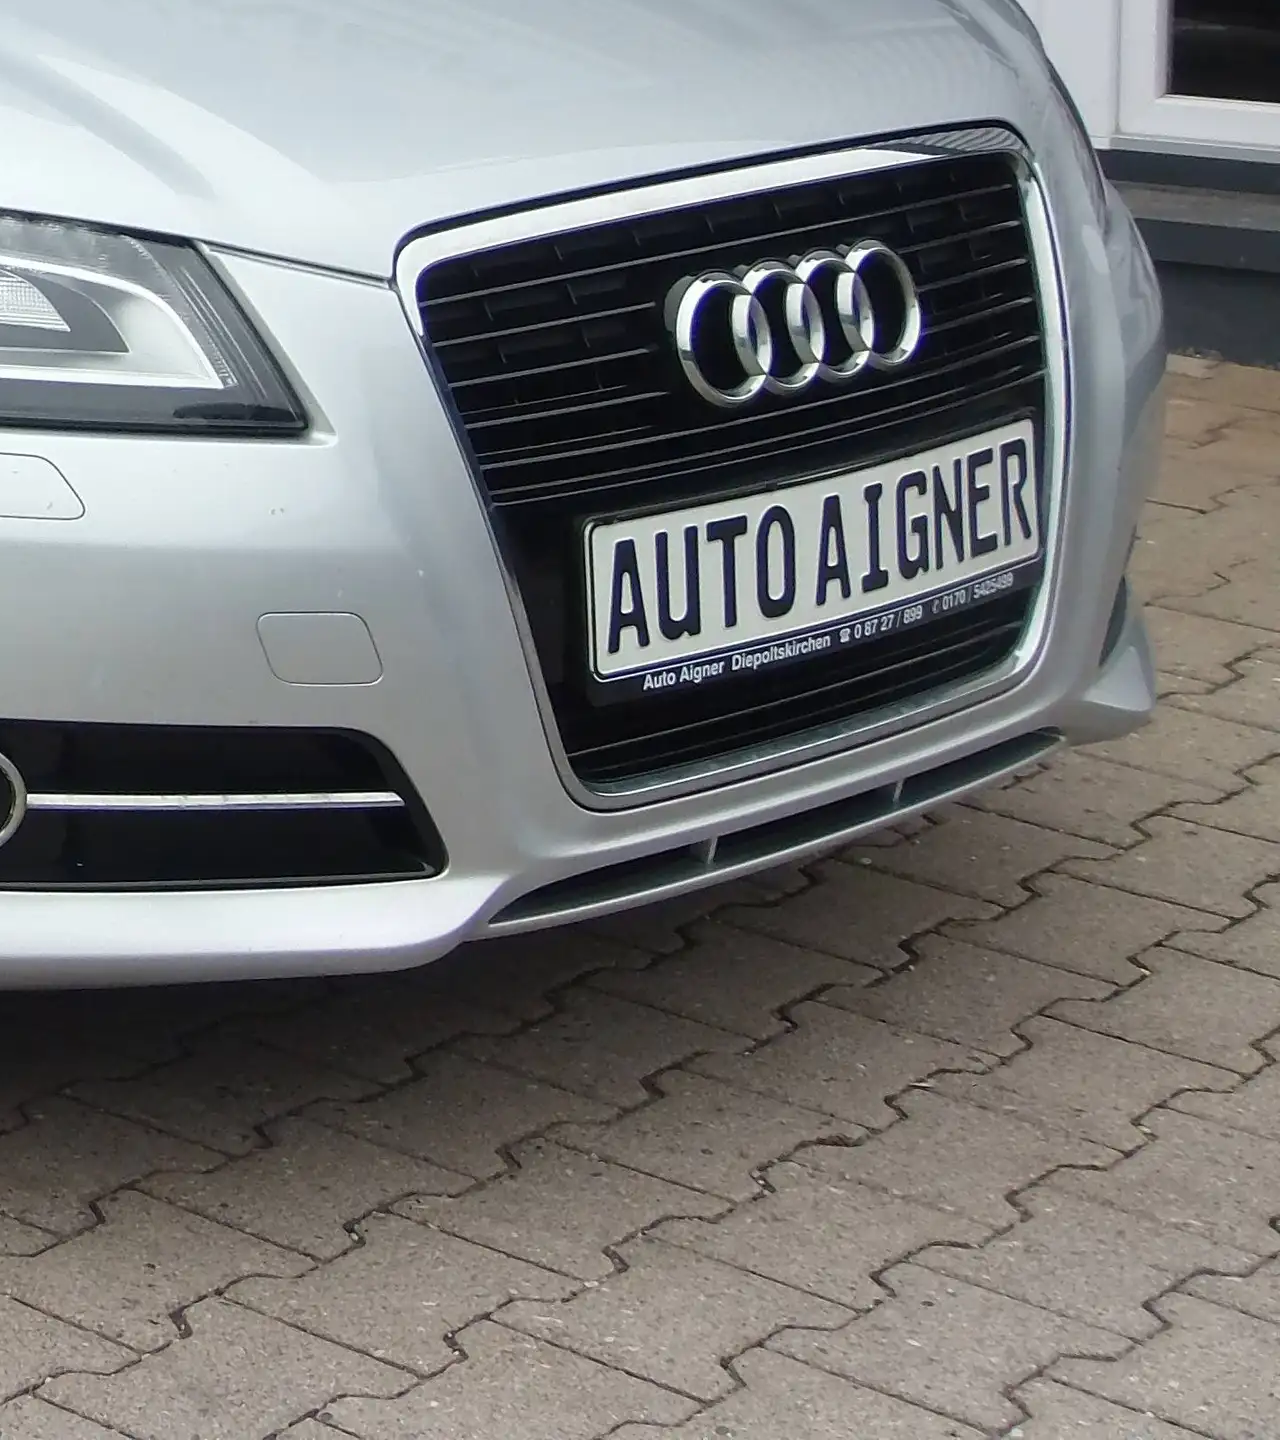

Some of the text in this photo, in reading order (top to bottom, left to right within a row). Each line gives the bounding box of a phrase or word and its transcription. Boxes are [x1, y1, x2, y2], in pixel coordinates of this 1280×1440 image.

[608, 437, 1033, 654] AUTO AIGNER
[643, 669, 676, 692] Auto
[680, 661, 725, 687] Aigner
[732, 635, 831, 671] Diepoltskirchen
